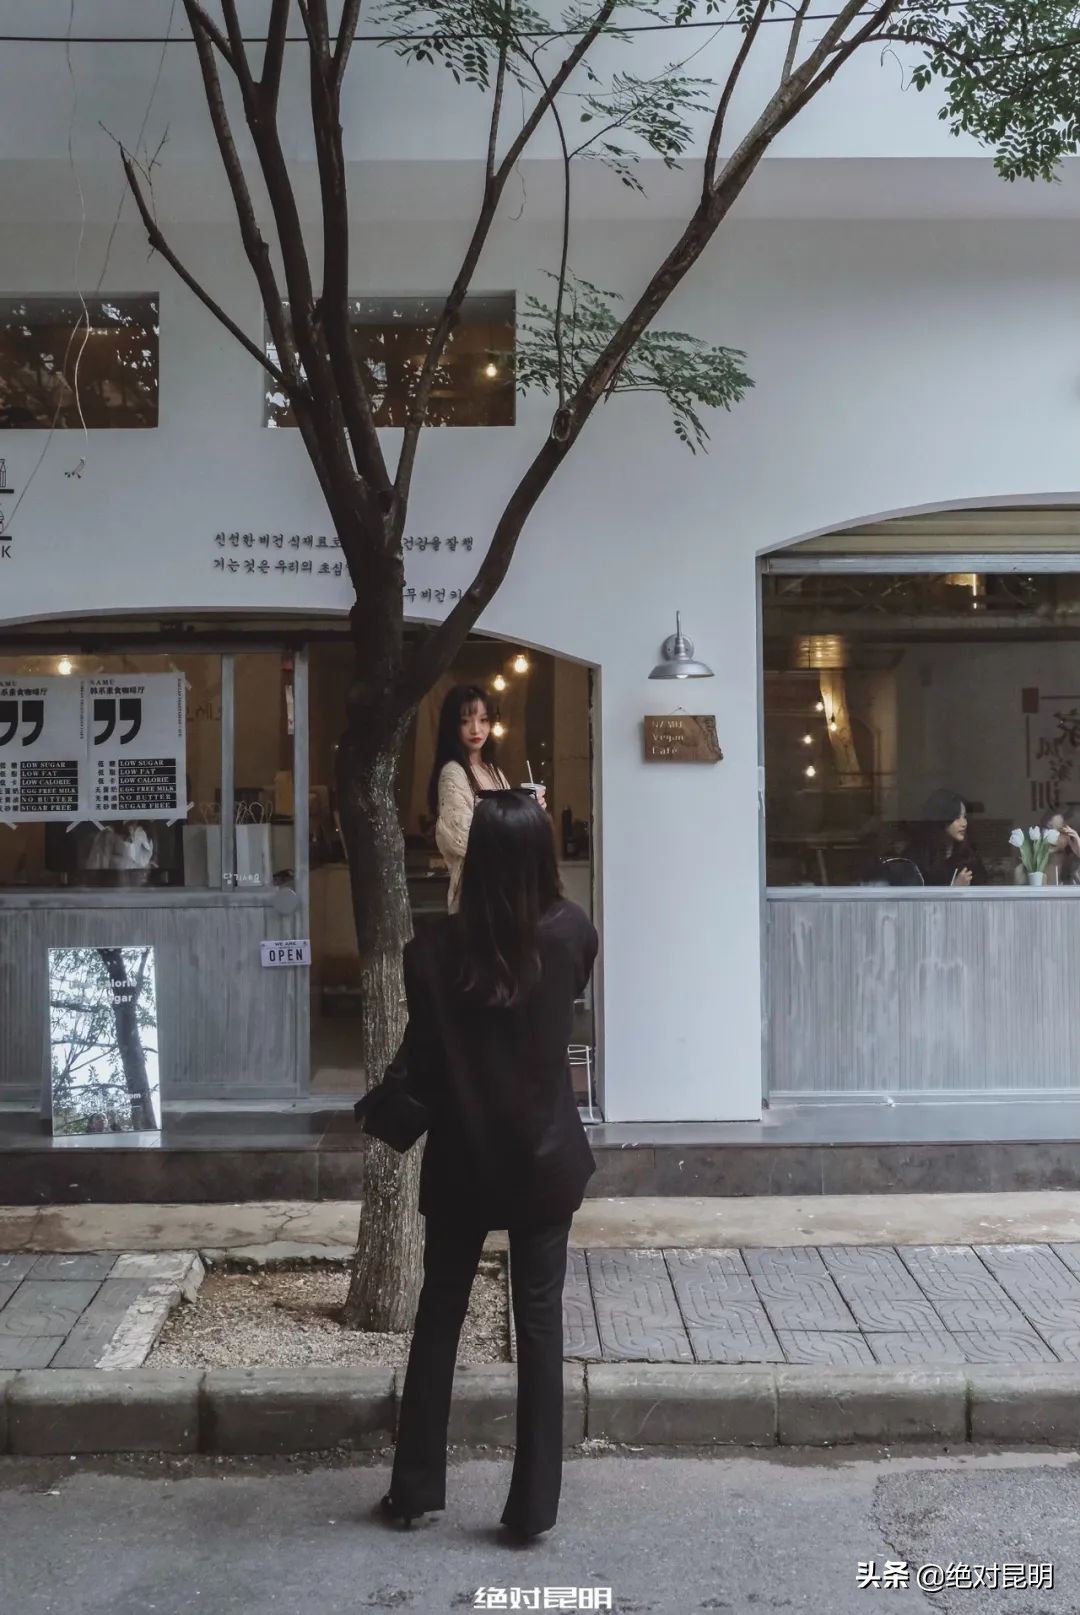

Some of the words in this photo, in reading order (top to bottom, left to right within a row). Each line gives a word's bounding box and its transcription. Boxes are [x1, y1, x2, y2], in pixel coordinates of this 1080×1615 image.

[213, 532, 255, 548] 신선한
[258, 533, 284, 548] 비건
[445, 536, 459, 551] 잘
[244, 559, 270, 574] 것은
[275, 560, 312, 574] 우리의
[317, 561, 349, 577] 초심
[420, 588, 445, 602] 비건
[269, 949, 303, 961] OPEN
